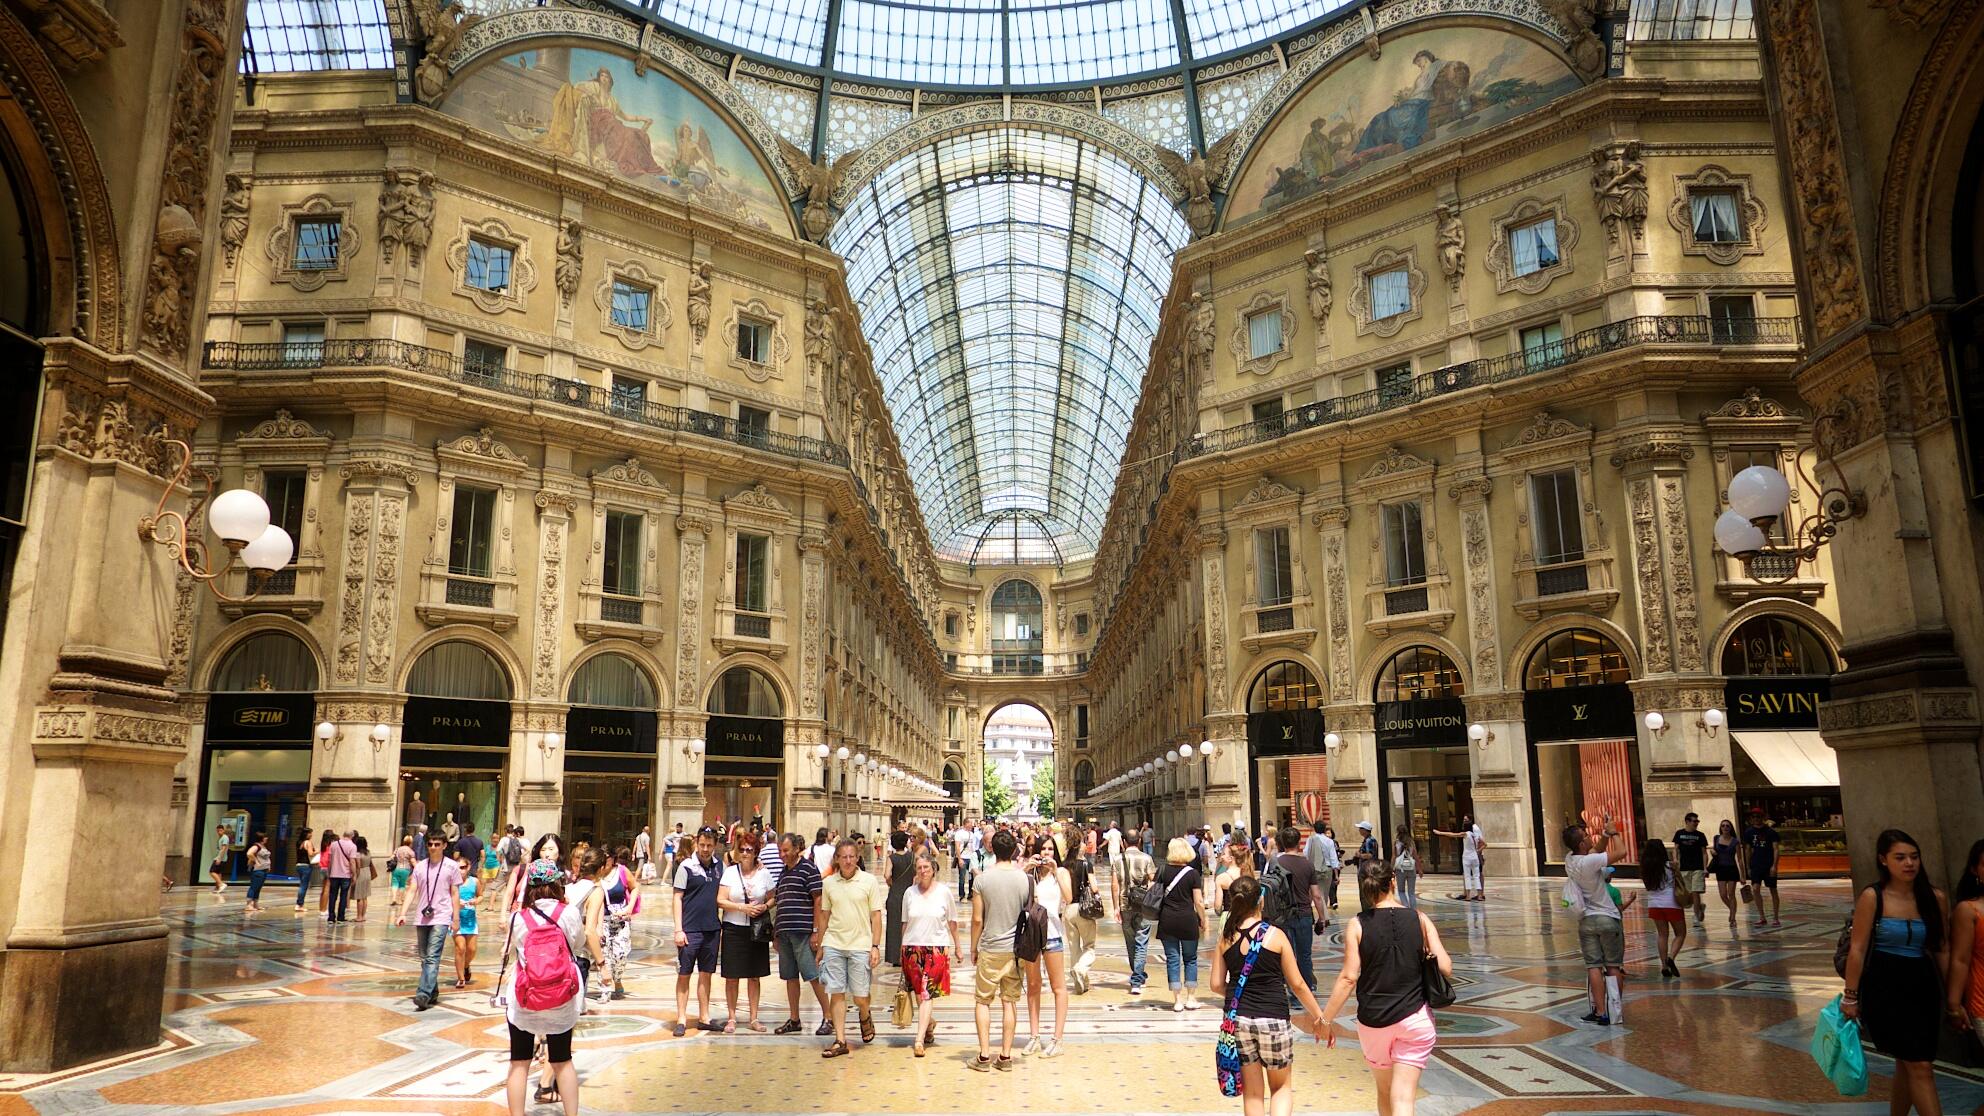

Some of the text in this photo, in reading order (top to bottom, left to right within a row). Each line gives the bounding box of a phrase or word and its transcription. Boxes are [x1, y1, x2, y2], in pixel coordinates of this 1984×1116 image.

[259, 711, 283, 723] TIM
[432, 716, 481, 728] PRADA
[1384, 715, 1461, 731] LOUIS VUITTON
[590, 726, 632, 736] PRADA
[726, 732, 762, 742] PRADA
